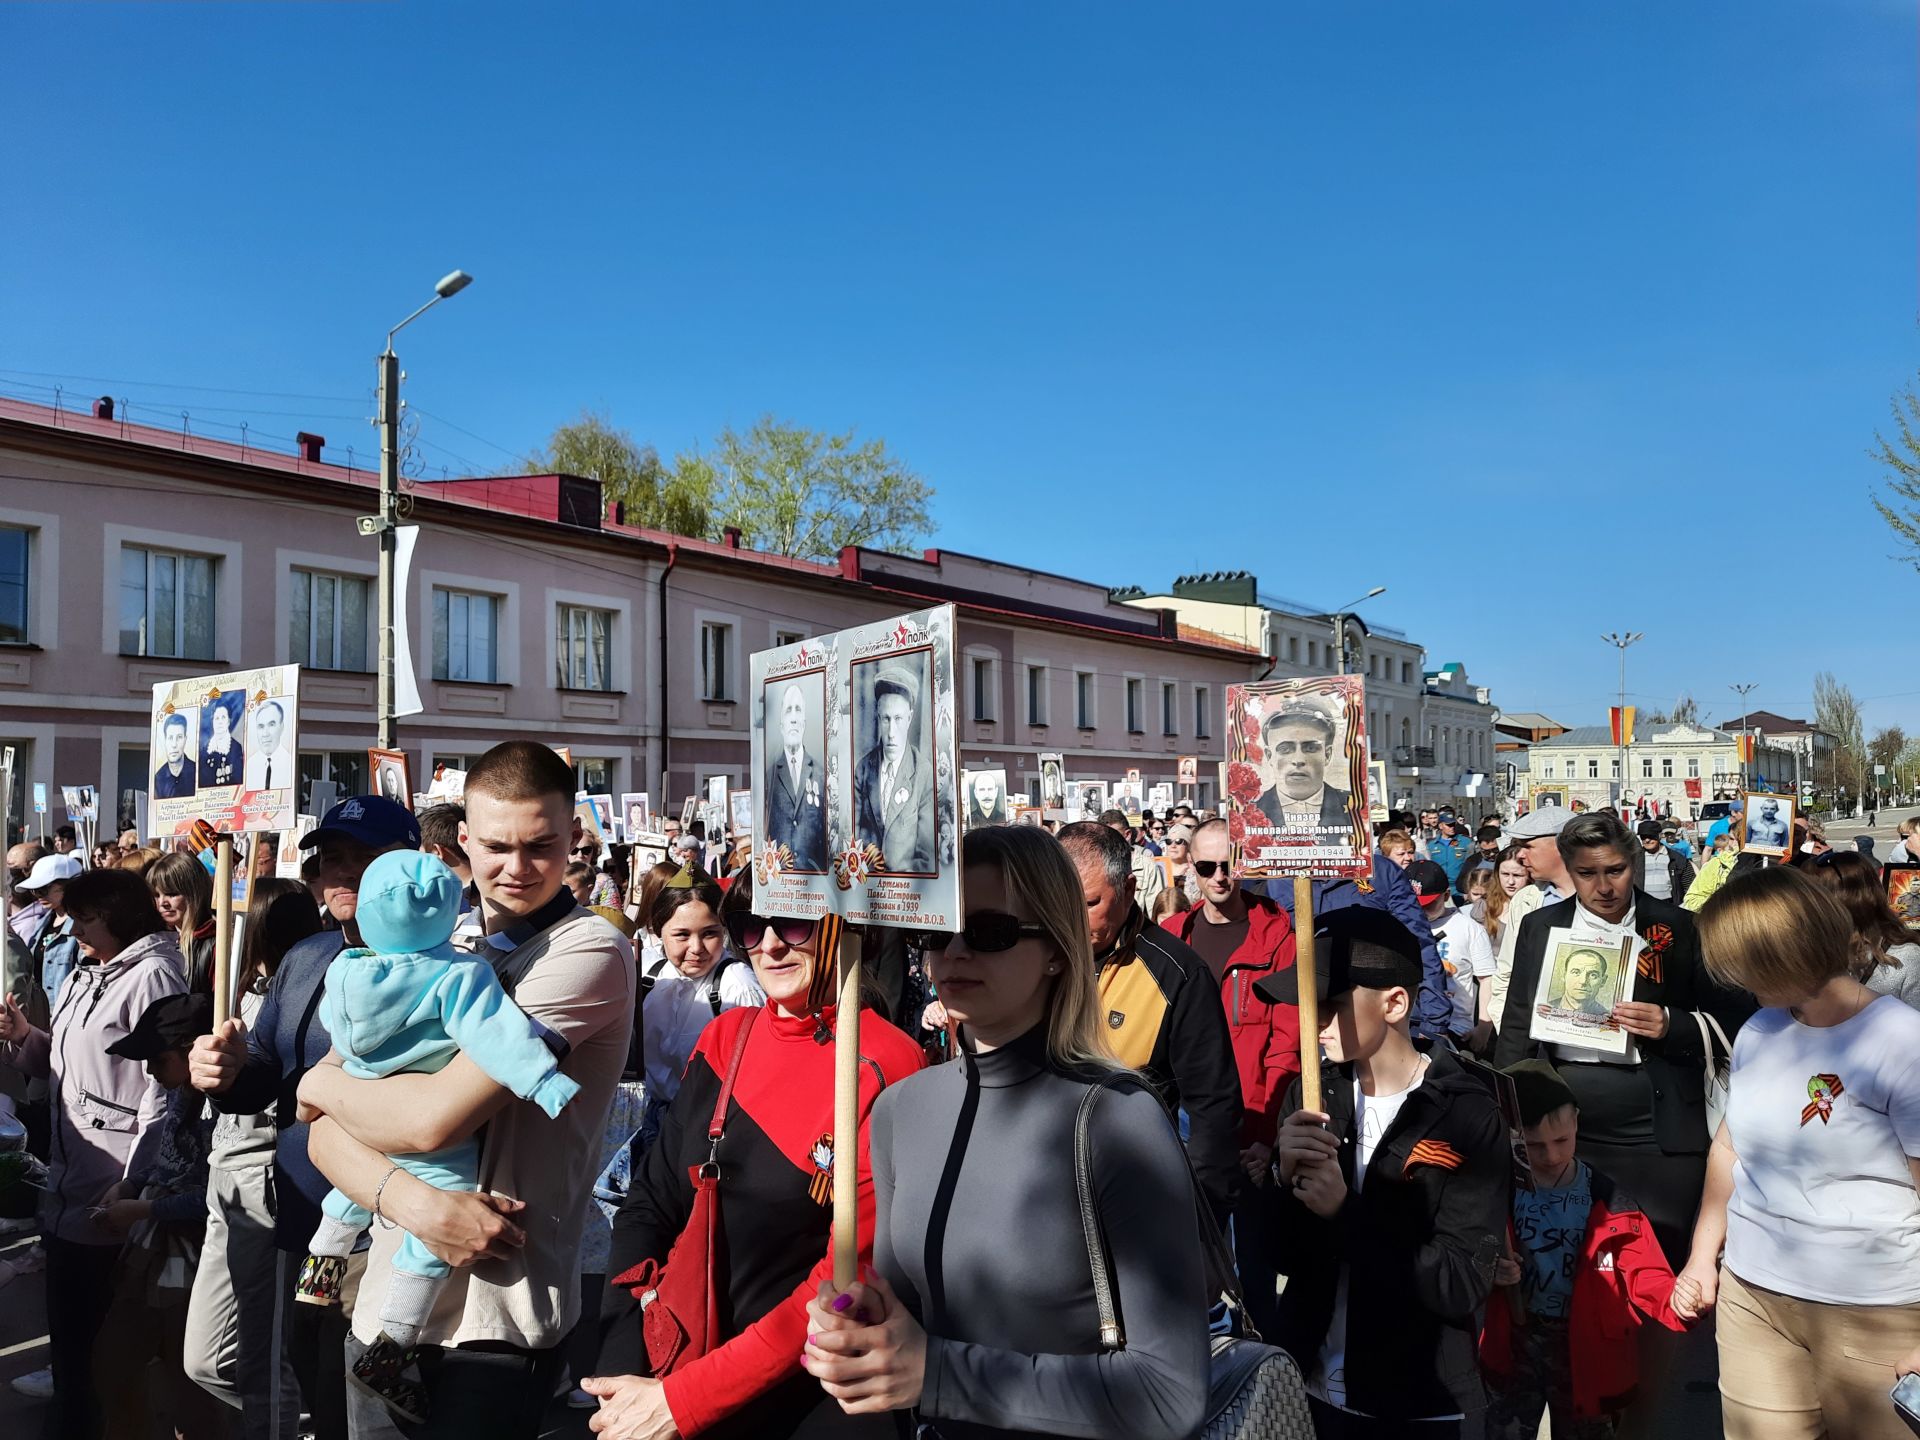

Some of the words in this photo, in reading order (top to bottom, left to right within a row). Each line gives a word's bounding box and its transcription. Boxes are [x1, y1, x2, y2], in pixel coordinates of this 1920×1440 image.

[1284, 812, 1321, 822] Князев
[1245, 825, 1288, 835] Николай
[1290, 825, 1354, 835] Васильевич
[1275, 834, 1327, 843] Красноармеец
[767, 889, 793, 901] Александр
[795, 890, 825, 903] Петрович
[867, 889, 886, 899] Павел
[887, 889, 922, 900] Петрович
[870, 901, 896, 912] призван
[847, 911, 868, 921] пропал
[869, 910, 879, 920] без
[880, 914, 900, 922] вести
[905, 913, 923, 923] годы
